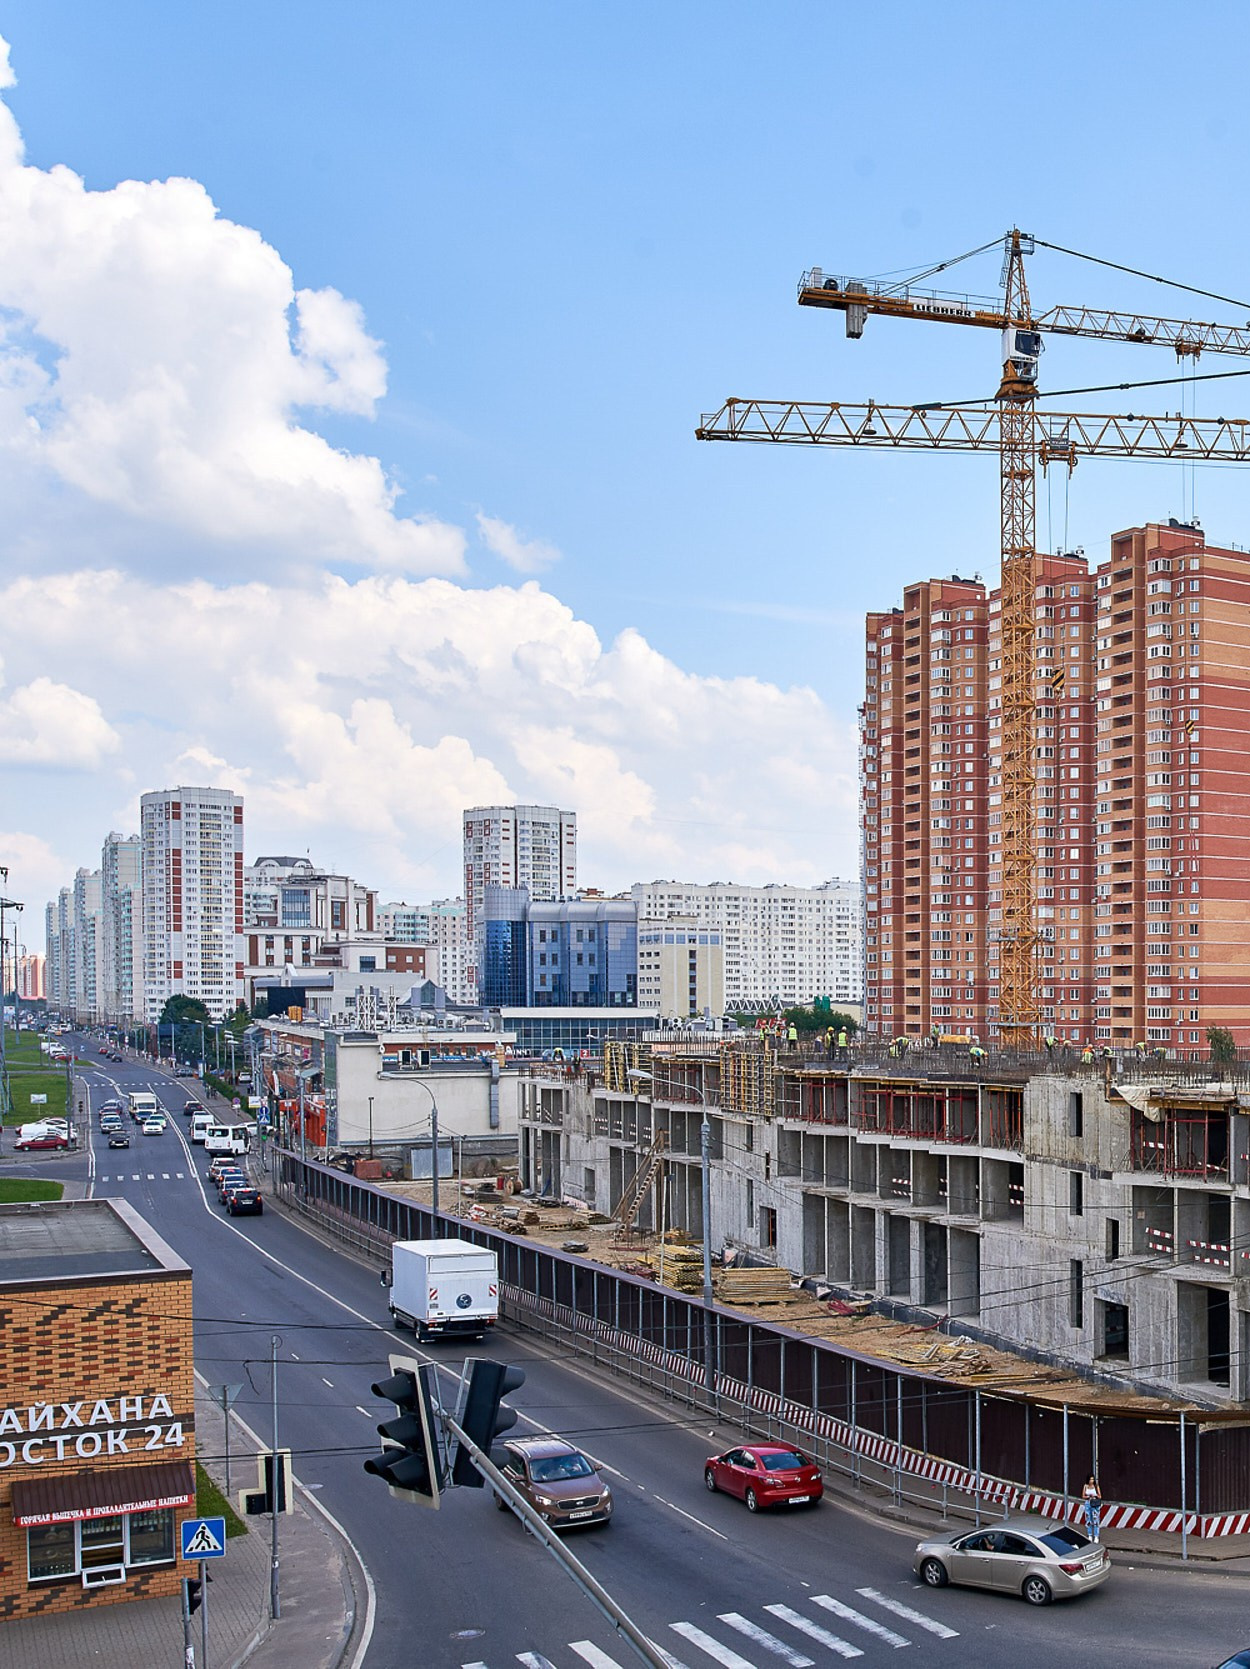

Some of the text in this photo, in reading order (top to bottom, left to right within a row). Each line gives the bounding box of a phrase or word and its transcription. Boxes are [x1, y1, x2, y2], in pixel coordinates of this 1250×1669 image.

[916, 304, 972, 317] LIEBHERR
[0, 1394, 174, 1435] АЙХАНА
[144, 1422, 185, 1451] 24
